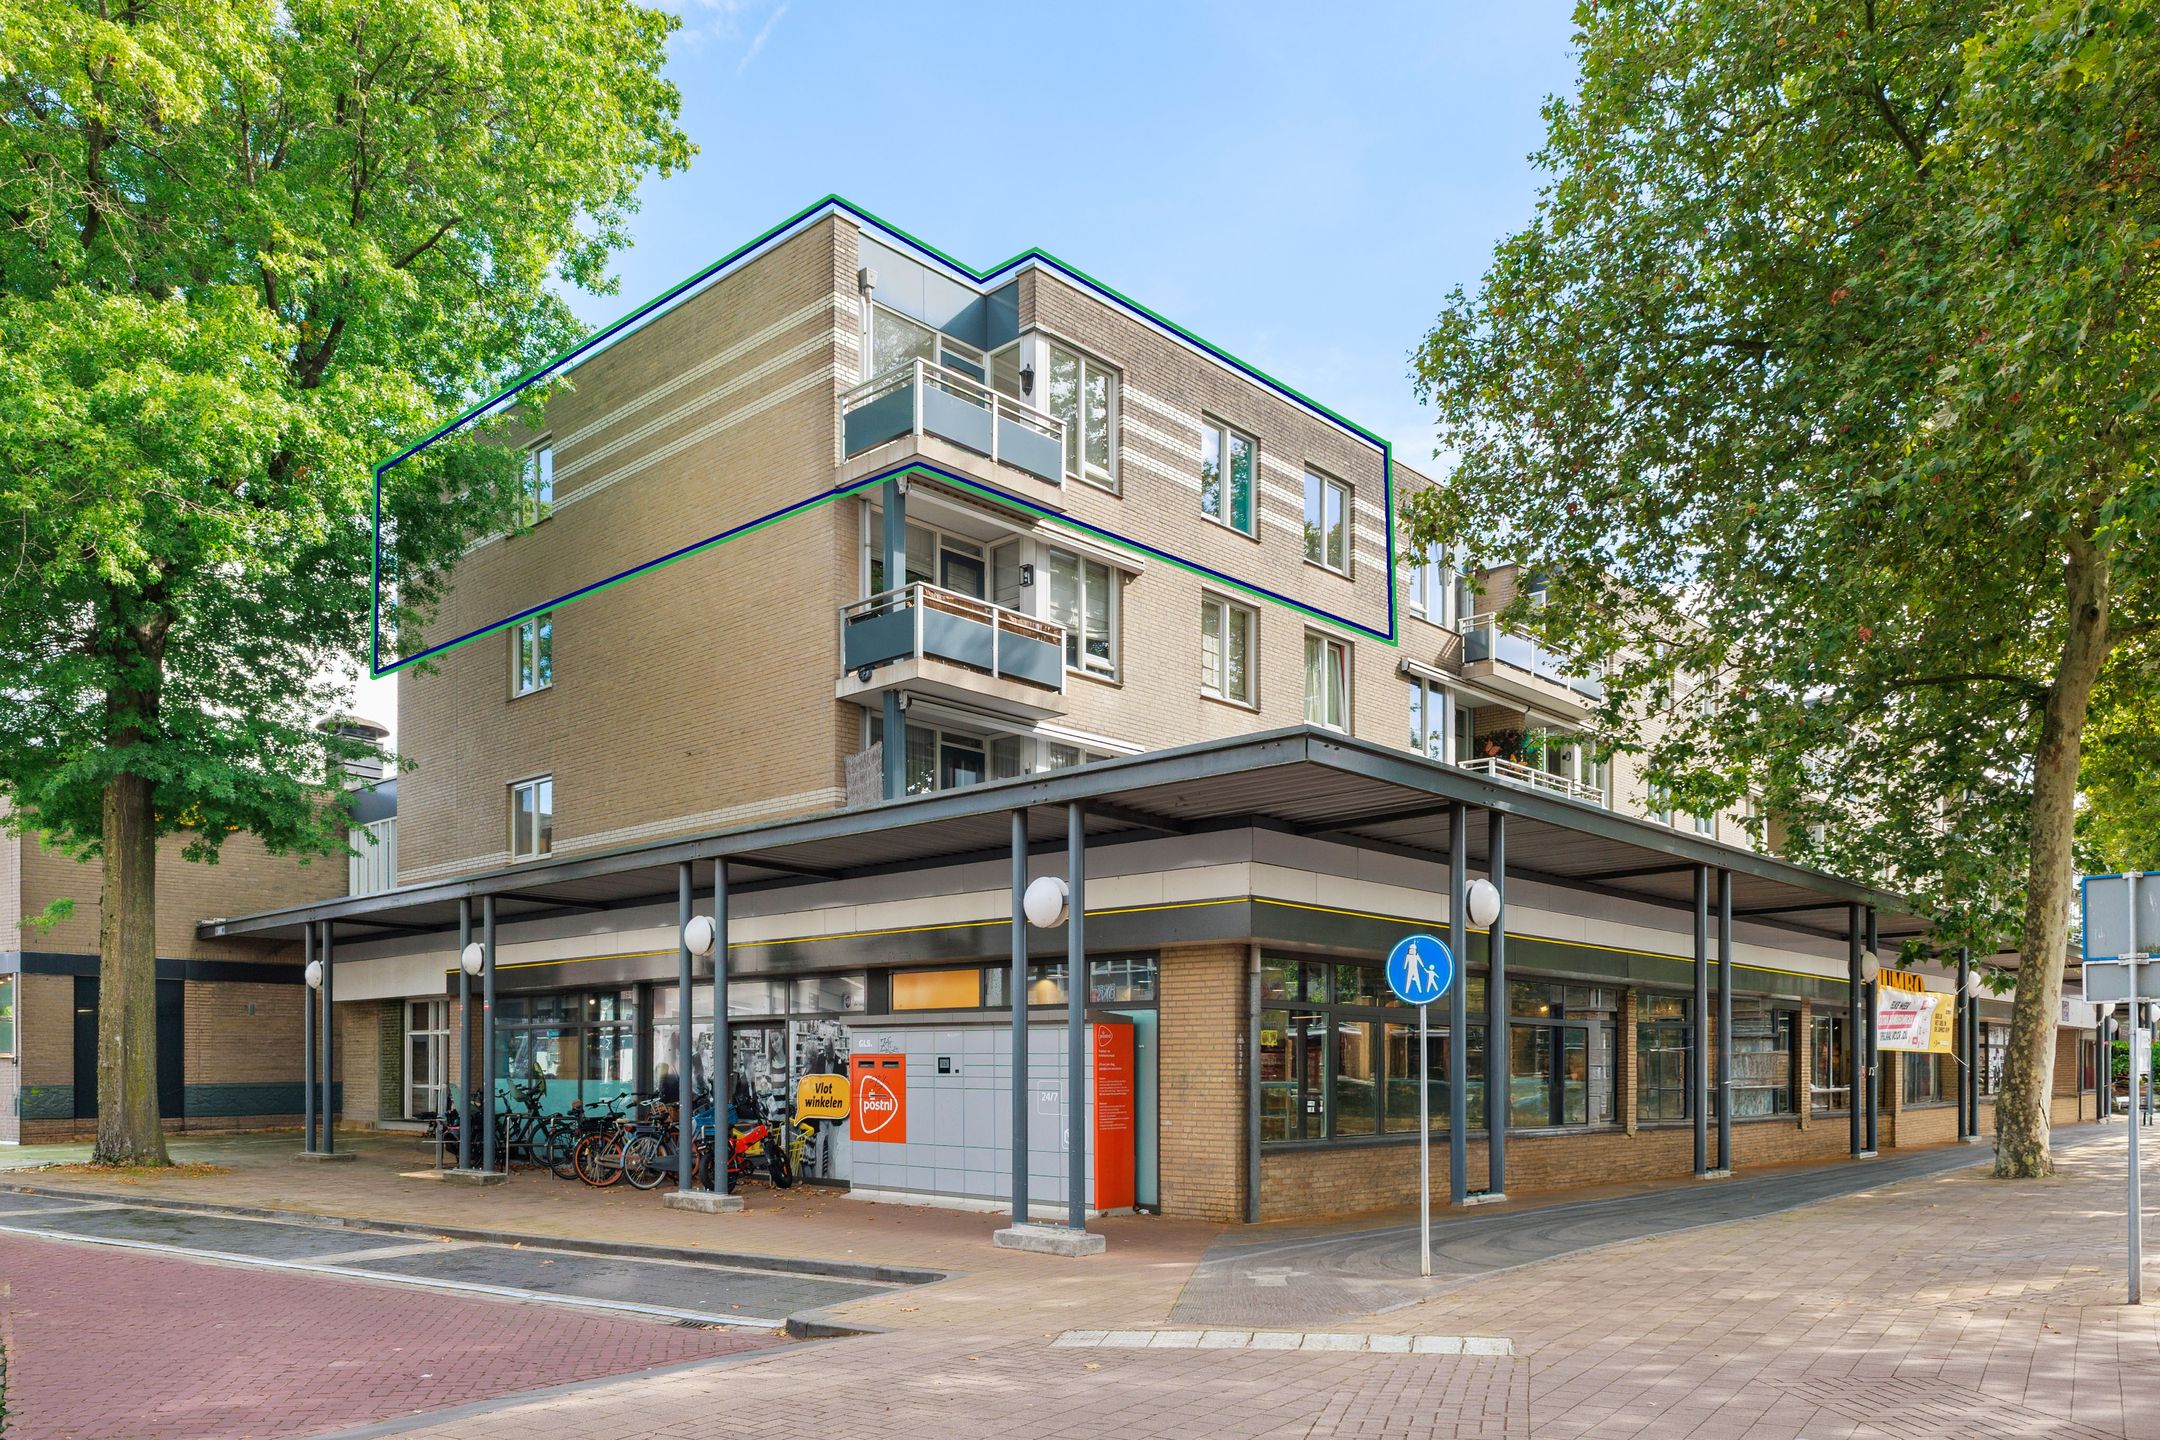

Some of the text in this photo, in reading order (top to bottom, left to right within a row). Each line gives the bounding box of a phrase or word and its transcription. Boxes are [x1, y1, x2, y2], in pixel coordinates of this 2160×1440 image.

[815, 1082, 833, 1094] Vlot
[805, 1096, 843, 1108] winkelen
[1041, 1092, 1058, 1102] 24/7
[863, 1098, 893, 1114] postnl
